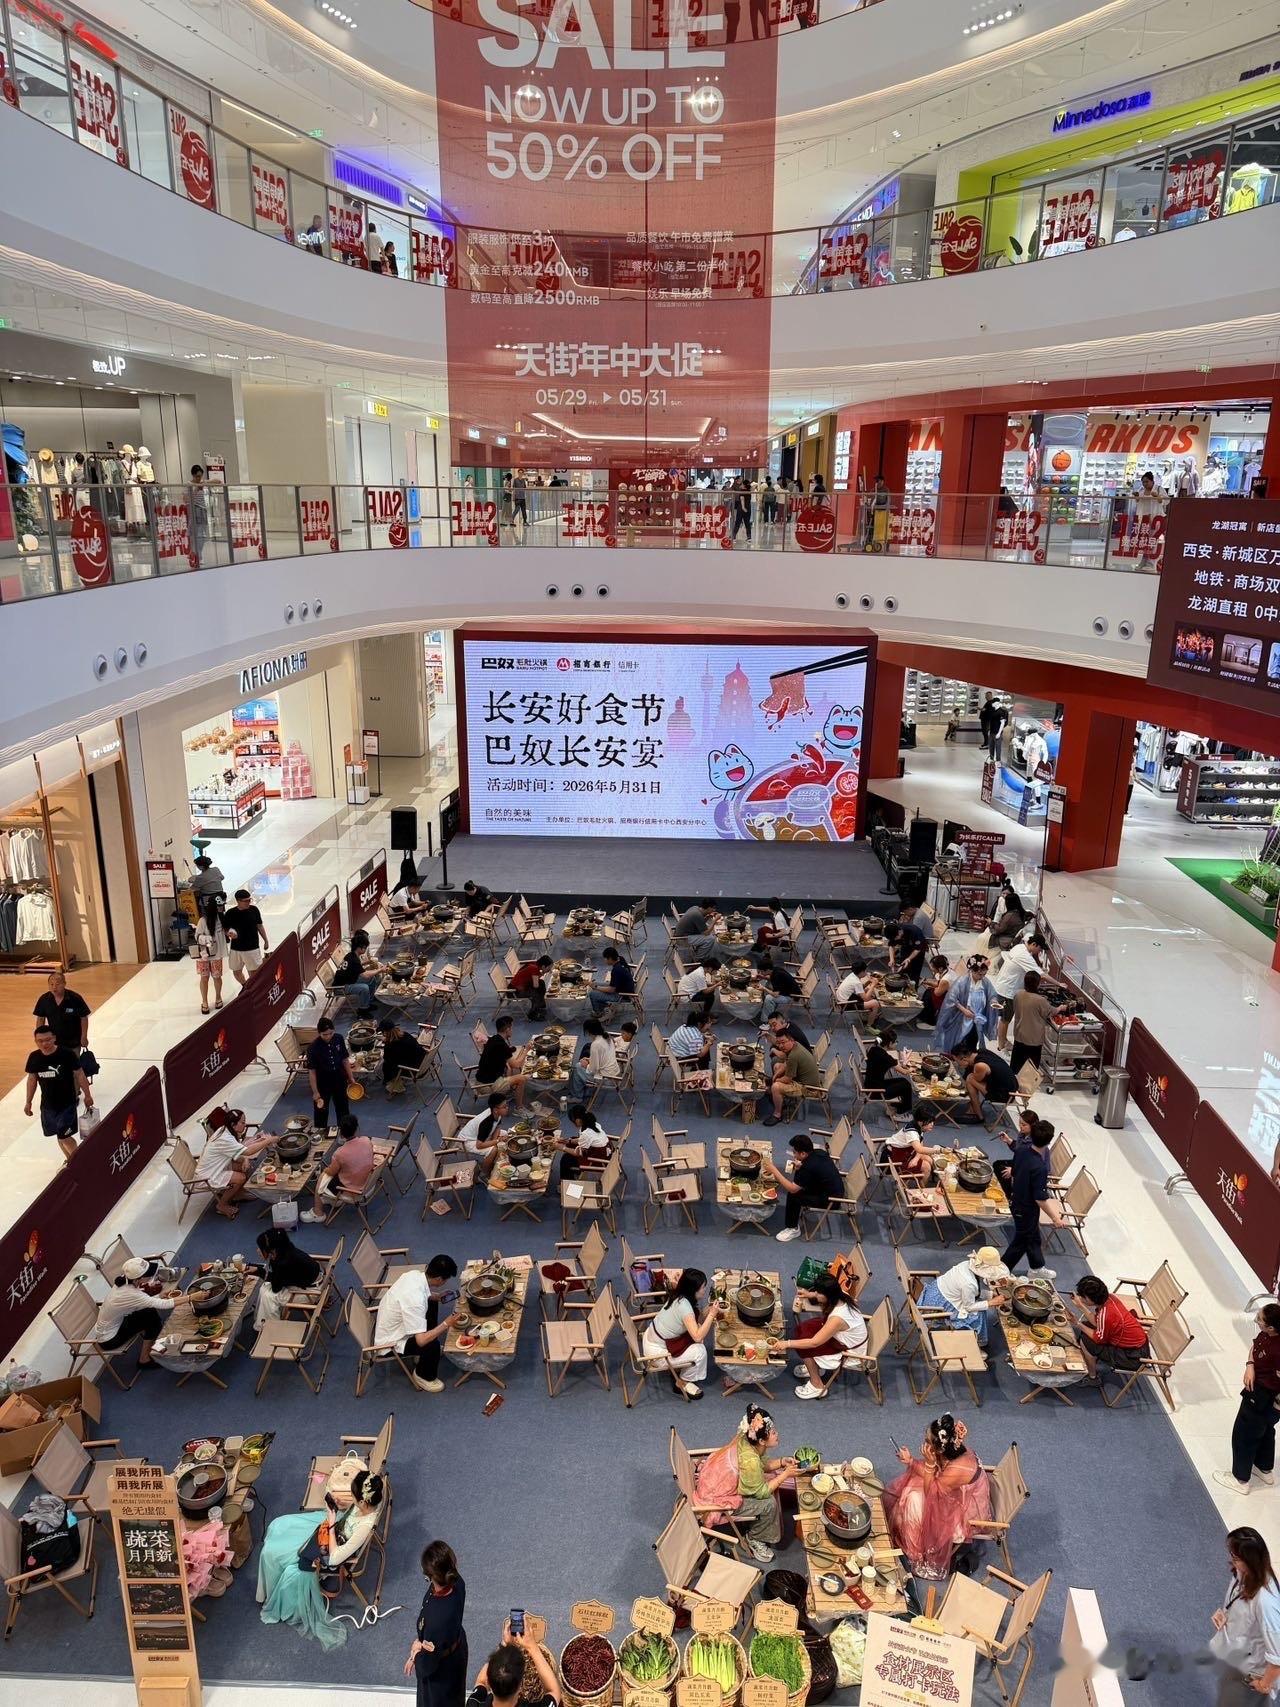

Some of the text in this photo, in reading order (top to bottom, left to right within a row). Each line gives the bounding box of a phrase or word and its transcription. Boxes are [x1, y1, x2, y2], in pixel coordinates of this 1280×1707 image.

[477, 0, 726, 70] SALE
[484, 85, 725, 125] NOW UP TO
[487, 131, 724, 181] 50% OFF
[515, 342, 703, 377] 天街年中大促
[536, 389, 587, 405] 05/29
[619, 389, 666, 406] 05/31
[1211, 520, 1248, 532] 龙湖冠寓
[1187, 595, 1280, 622] 龙湖直租 0中
[240, 656, 290, 694] AFIONA
[481, 657, 548, 670] 巴奴 毛肚火锅
[573, 660, 640, 669] 招商银行 信用卡
[483, 690, 665, 726] 长安好食节
[485, 734, 664, 769] 巴奴长安宴
[487, 778, 661, 795] 活动时间：2026年5月31日
[485, 808, 533, 817] 自然的美味
[360, 878, 378, 908] SALE
[311, 920, 330, 955] SALE
[267, 982, 280, 1005] 天街
[201, 1051, 220, 1078] 天街
[1145, 1072, 1160, 1103] 天街
[109, 1138, 131, 1175] 天街
[1216, 1166, 1237, 1205] 天街
[6, 1260, 34, 1311] 天街
[115, 1467, 162, 1477] 展我所用
[117, 1480, 164, 1490] 用我所展
[122, 1506, 167, 1516] 绝无虚假
[124, 1529, 172, 1548] 蔬菜
[127, 1549, 173, 1563] 月月新
[883, 1651, 954, 1685] 食材展示区
